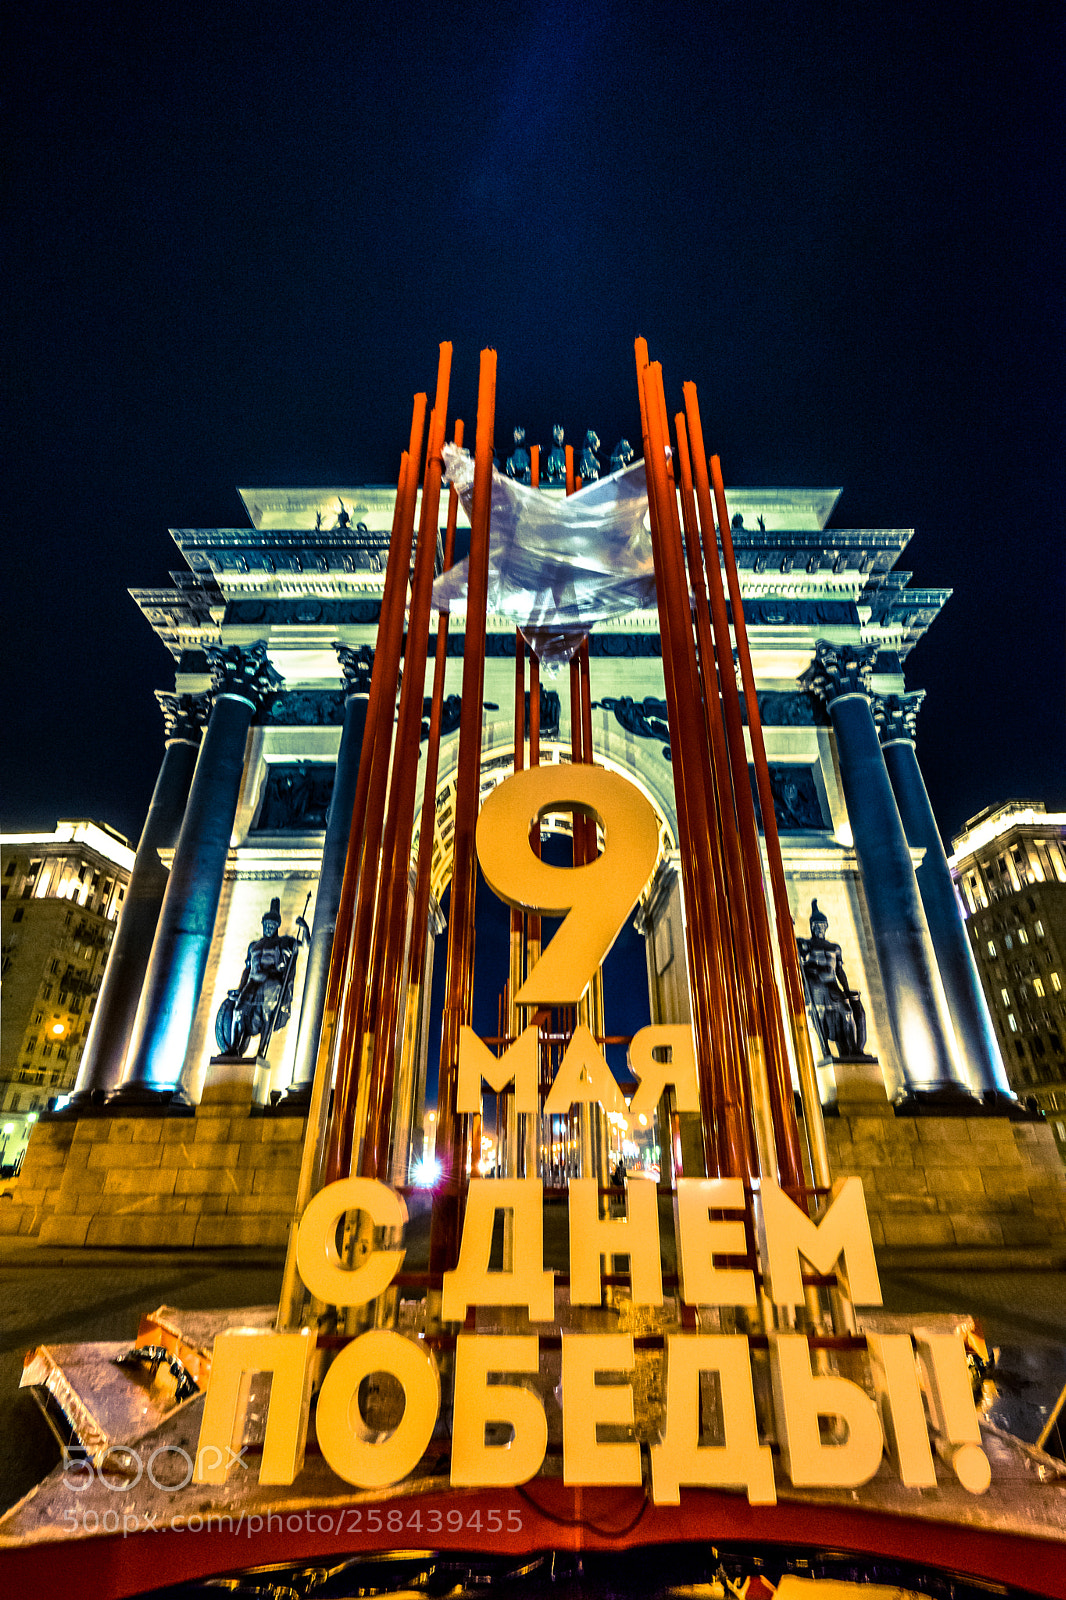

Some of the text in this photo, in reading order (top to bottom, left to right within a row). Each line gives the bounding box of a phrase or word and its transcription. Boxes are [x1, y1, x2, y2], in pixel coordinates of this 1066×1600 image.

[475, 763, 661, 1006] 9
[457, 1023, 701, 1113] МАЯ
[297, 1176, 883, 1322] С ДНЕМ
[192, 1326, 991, 1507] ПОБЕДЫ!
